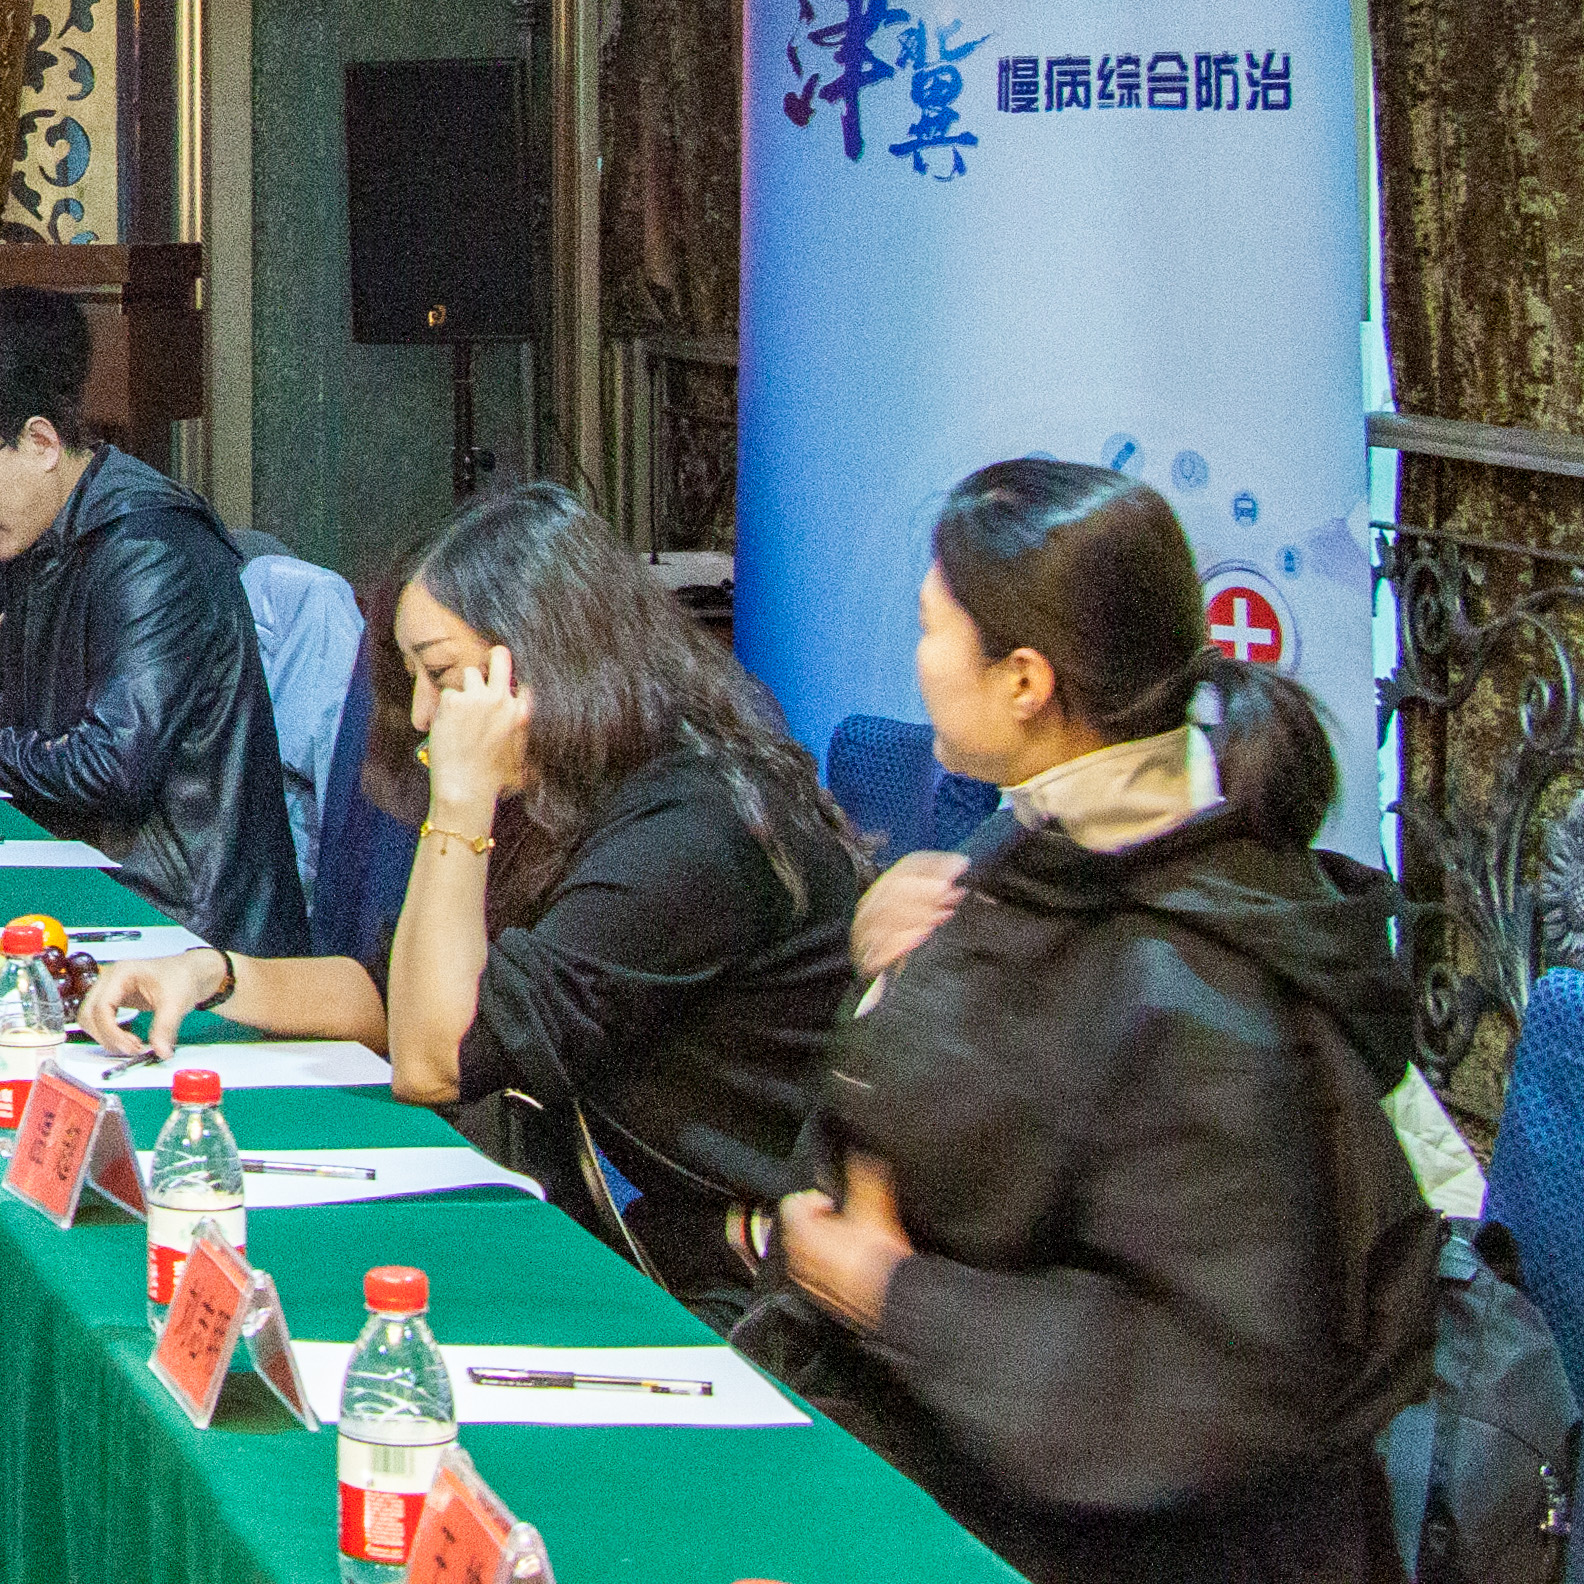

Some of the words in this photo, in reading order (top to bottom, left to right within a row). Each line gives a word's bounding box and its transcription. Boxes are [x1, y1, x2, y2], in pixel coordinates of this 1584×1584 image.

[997, 50, 1293, 115] 慢病综合防治
